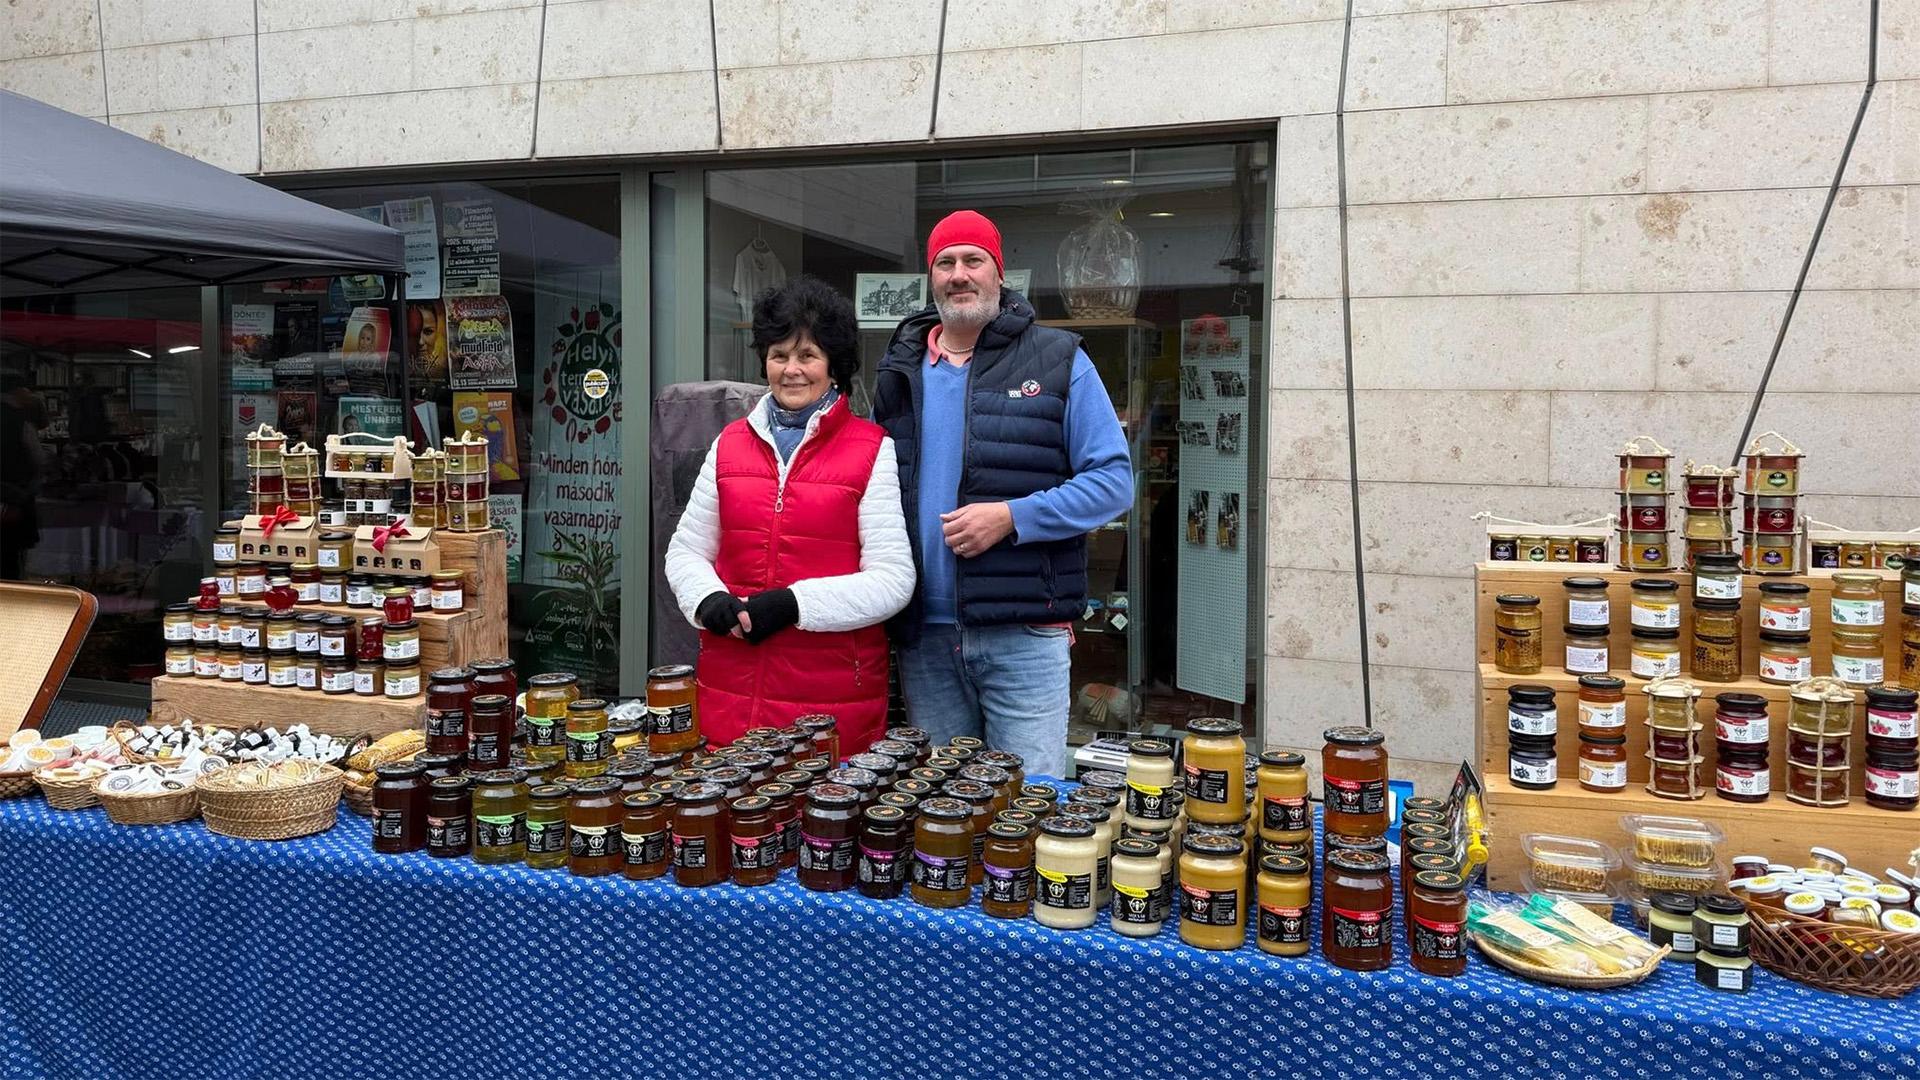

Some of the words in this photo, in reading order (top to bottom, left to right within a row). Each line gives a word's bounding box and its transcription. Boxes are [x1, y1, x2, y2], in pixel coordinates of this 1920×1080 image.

[567, 337, 613, 367] Helyi
[351, 403, 402, 414] MESTEREK
[538, 453, 589, 474] Minden
[556, 480, 615, 502] második
[490, 507, 518, 517] ására
